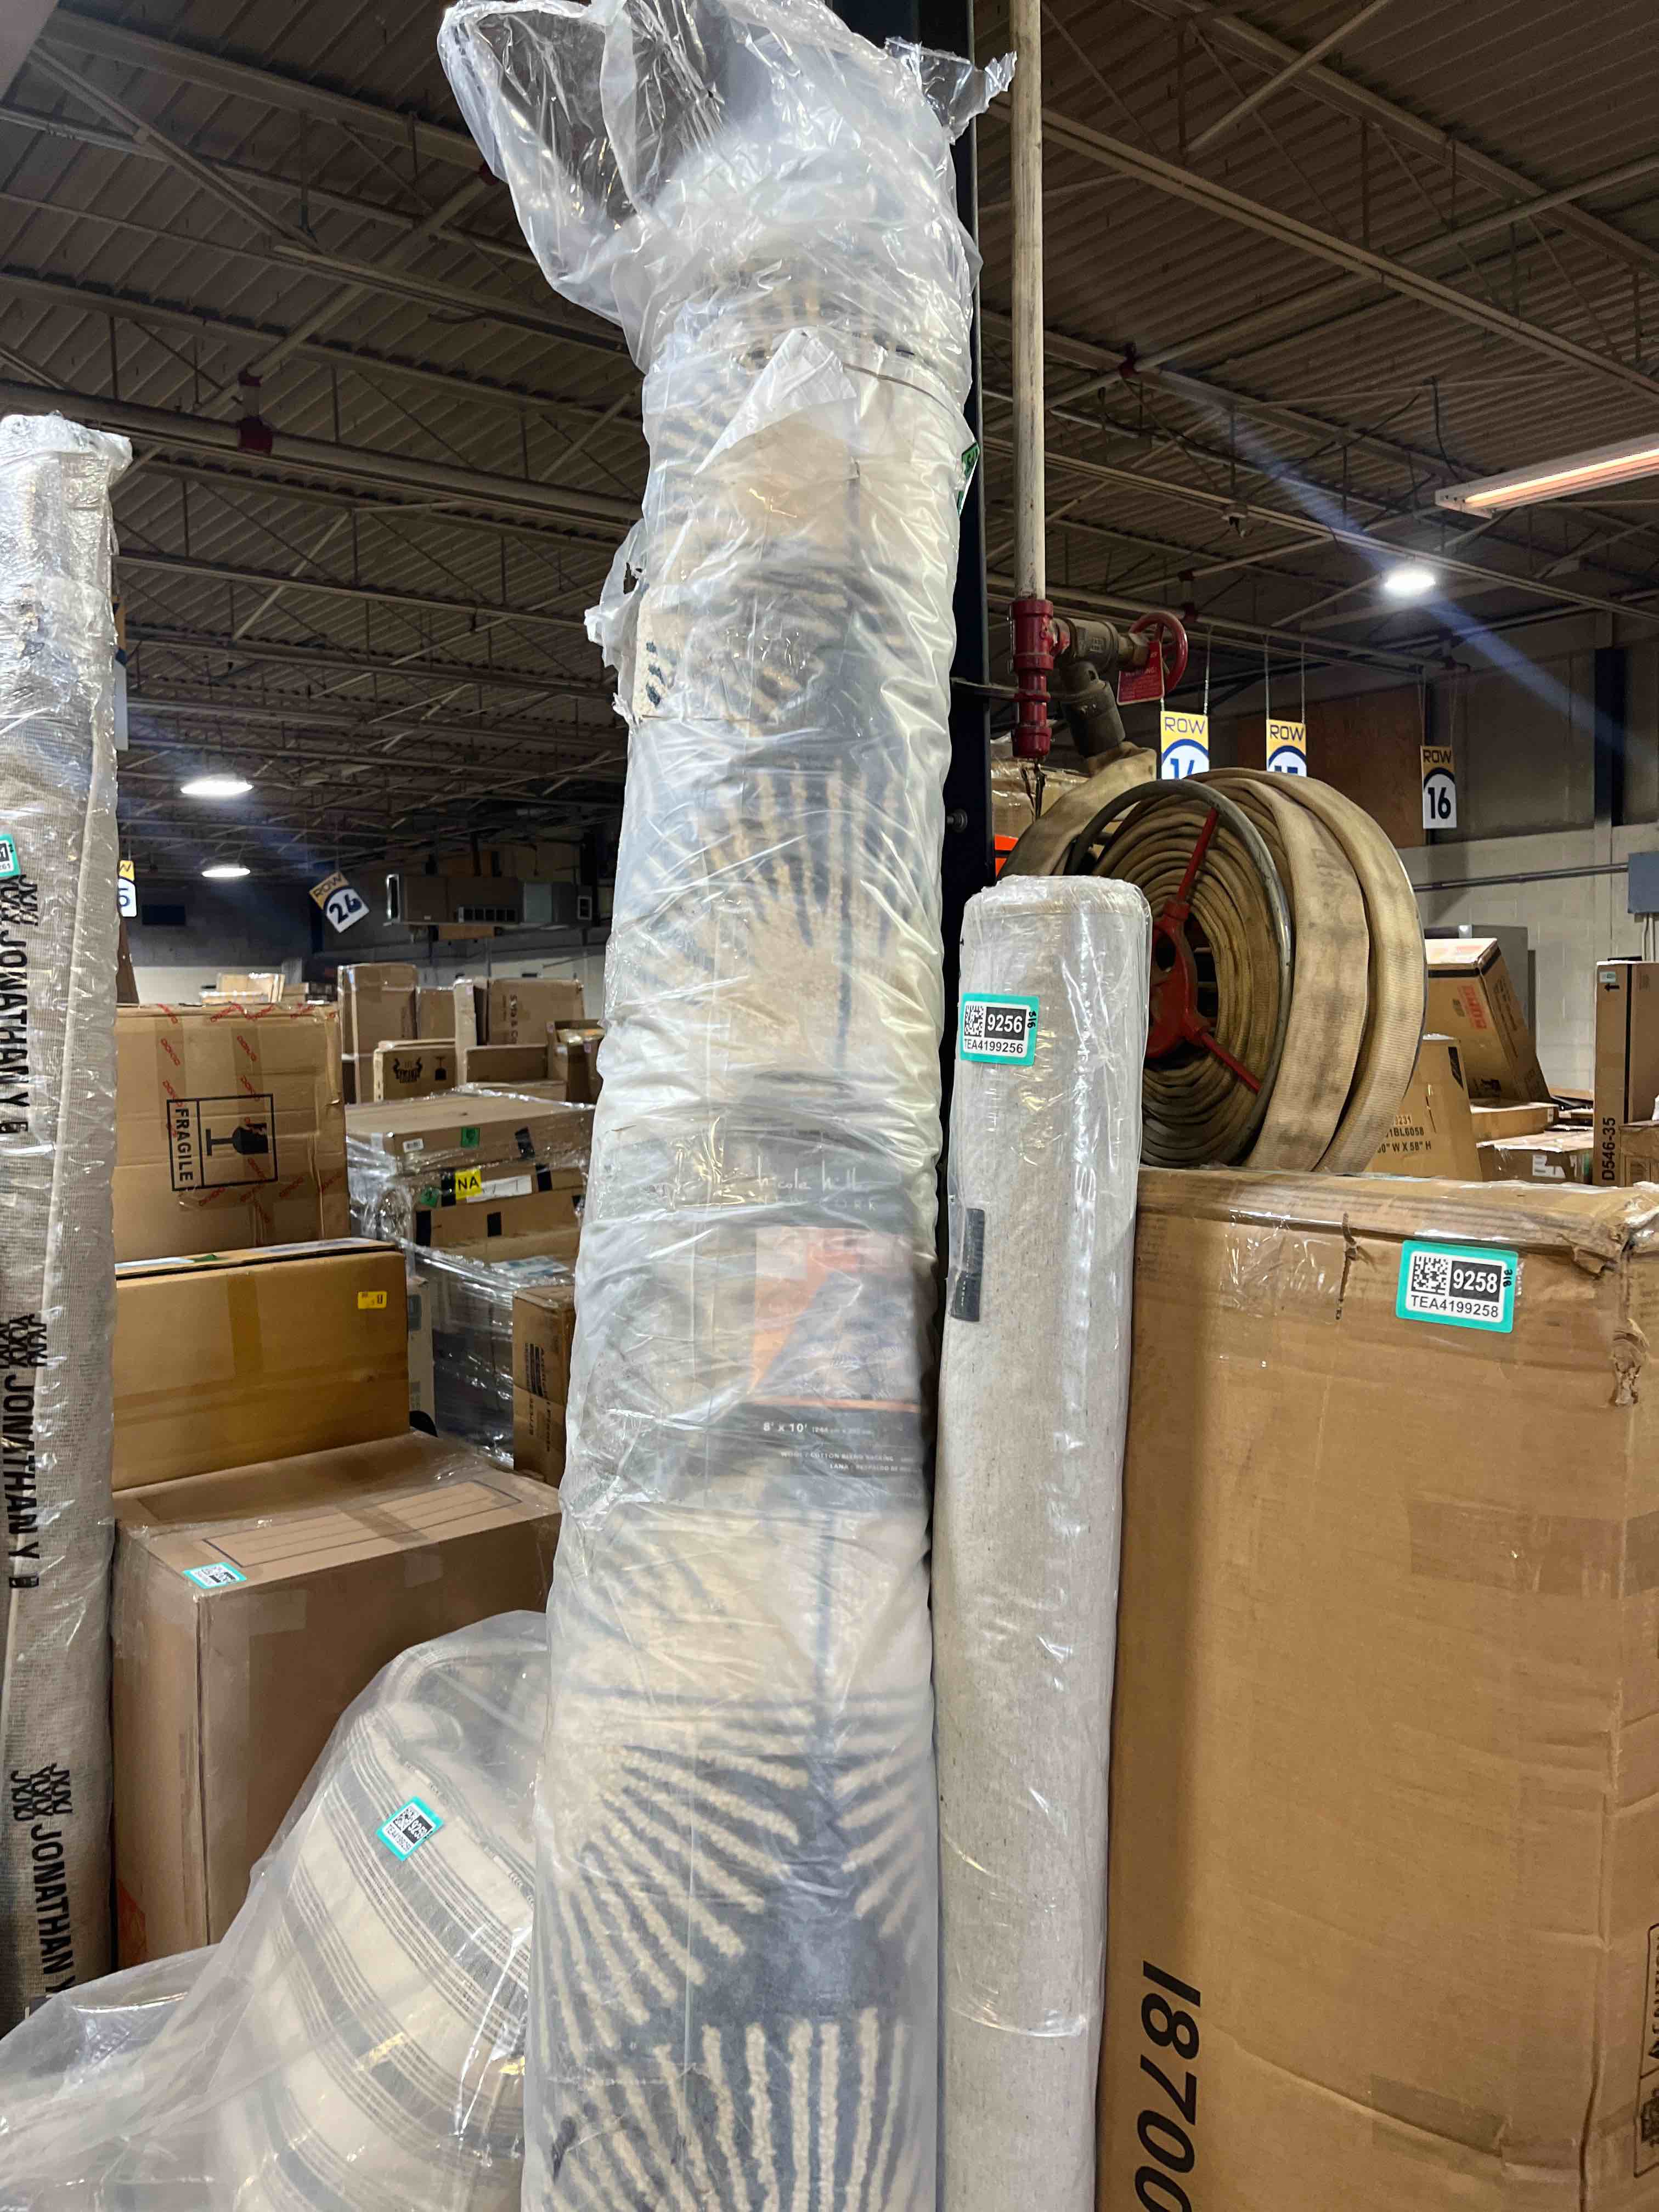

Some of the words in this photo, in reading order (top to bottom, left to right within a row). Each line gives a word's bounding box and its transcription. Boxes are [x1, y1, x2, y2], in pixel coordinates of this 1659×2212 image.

[1165, 716, 1205, 735] ROW
[1269, 724, 1304, 741] ROW
[1423, 749, 1452, 763] ROW
[1428, 787, 1451, 819] 16
[313, 873, 343, 898] ROW
[329, 893, 362, 924] 26
[987, 1013, 1023, 1033] 9256
[964, 1038, 1024, 1054] TEA4199256
[175, 1108, 194, 1181] FRAGILE
[1601, 1117, 1616, 1181] D546-35
[458, 1176, 479, 1190] NA
[1453, 1268, 1498, 1294] 9258
[1411, 1295, 1499, 1318] TEA4199258
[2, 1373, 41, 1536] JONATHAN
[8, 1541, 40, 1560] Y
[30, 1823, 75, 1975] JONATHAN
[1135, 1960, 1201, 2212] 18700
